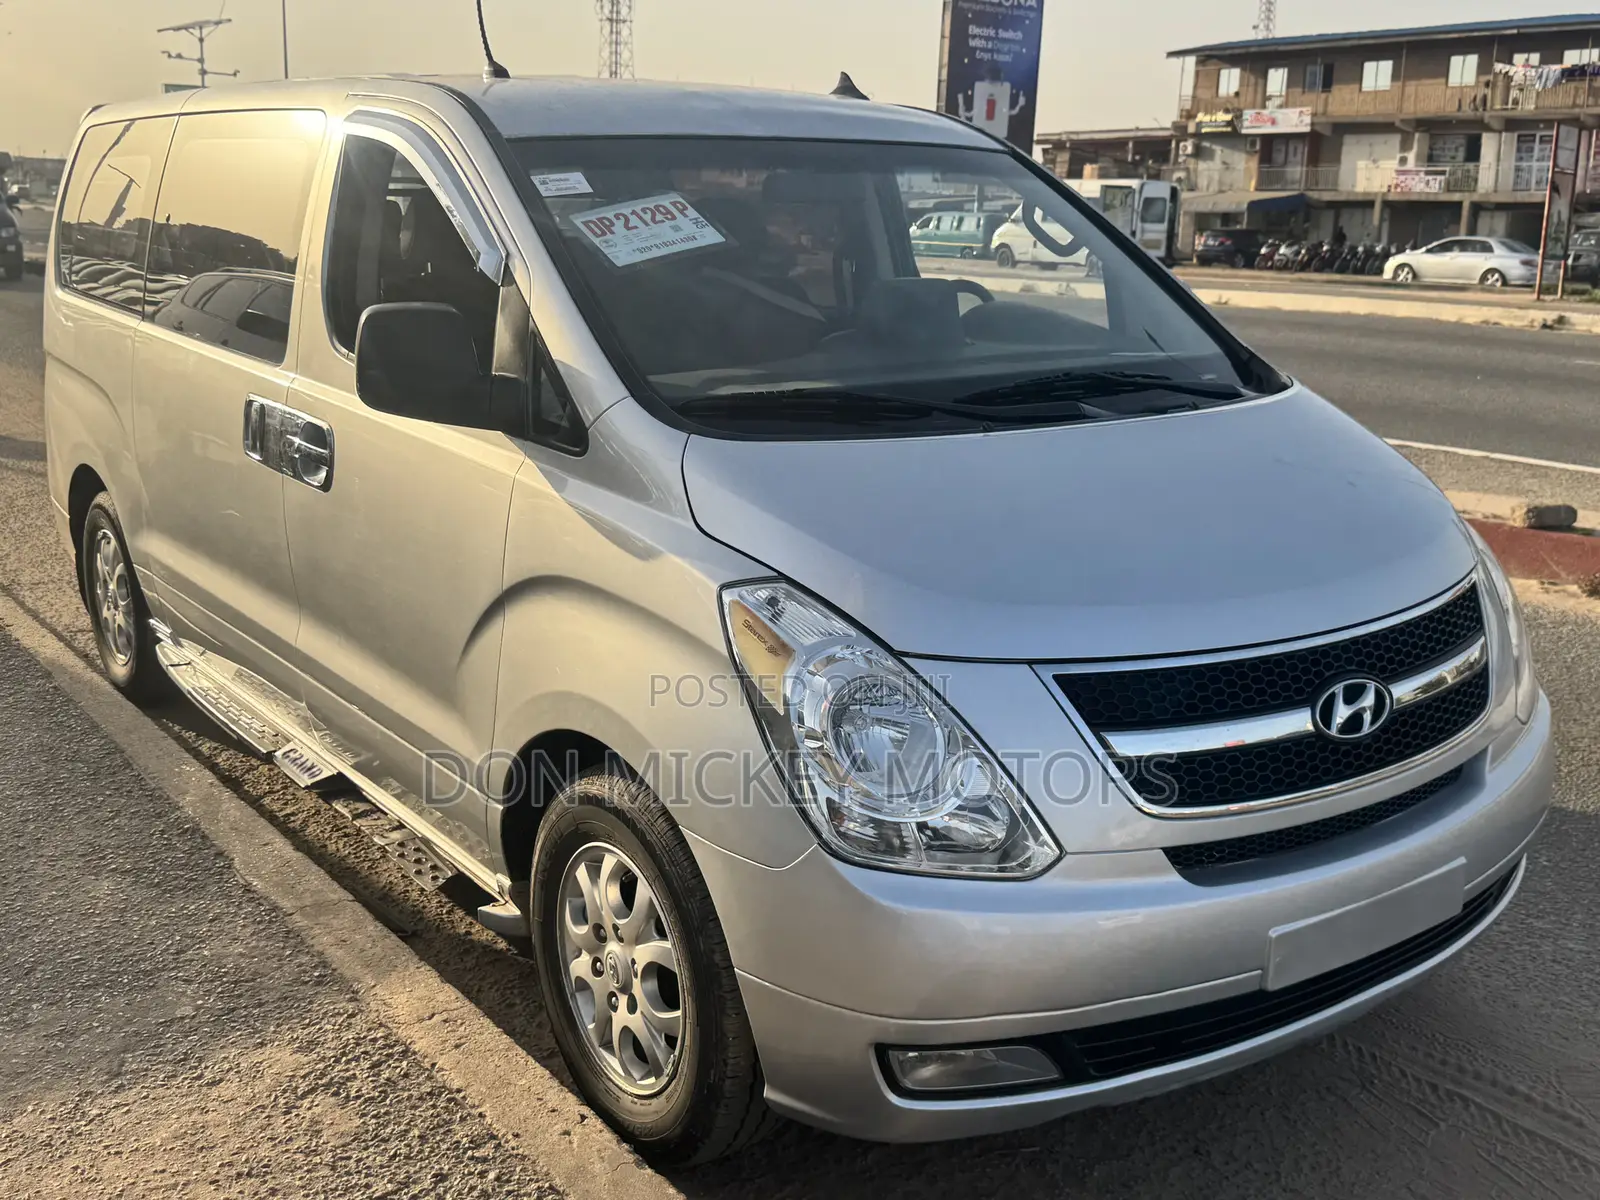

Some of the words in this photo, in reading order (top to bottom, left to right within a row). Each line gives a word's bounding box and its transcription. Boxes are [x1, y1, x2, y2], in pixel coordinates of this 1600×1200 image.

[581, 215, 616, 239] DP
[615, 204, 677, 231] 2129
[669, 201, 689, 218] P
[695, 222, 710, 230] GH
[741, 618, 769, 647] Starex
[281, 748, 323, 779] GRAND
